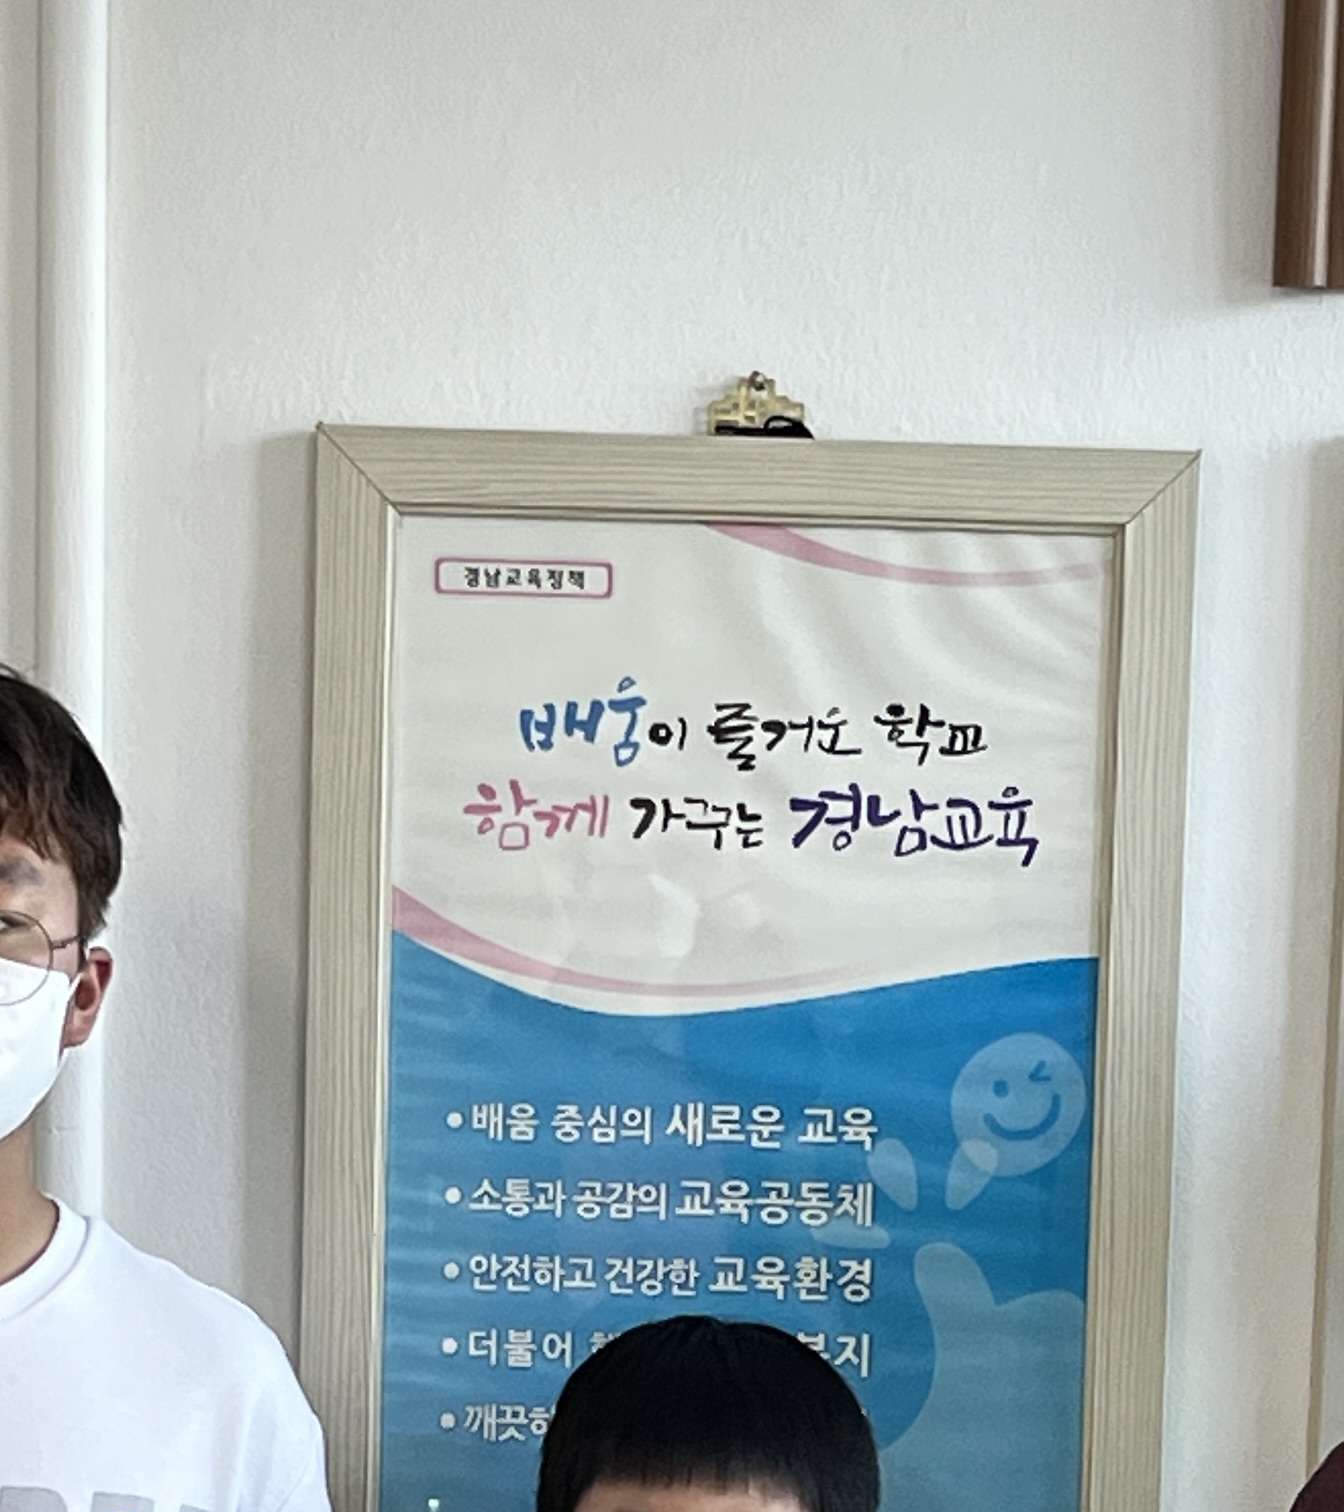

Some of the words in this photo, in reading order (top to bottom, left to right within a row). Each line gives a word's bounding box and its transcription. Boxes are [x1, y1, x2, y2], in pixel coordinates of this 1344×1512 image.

[463, 566, 585, 590] 경남교육정책
[519, 675, 688, 769] 배움이
[706, 701, 864, 772] 즐거운
[872, 702, 990, 767] 학교
[463, 779, 609, 853] 함께
[628, 796, 765, 852] 가꾸는
[789, 782, 1041, 868] 경남교육
[471, 1102, 539, 1141] 배움
[550, 1102, 654, 1145] 중심의
[664, 1101, 786, 1150] 새로운
[797, 1105, 879, 1151] 교육
[467, 1177, 566, 1218] 소통과
[573, 1179, 668, 1221] 공감의
[674, 1178, 874, 1228] 교육공동체
[468, 1253, 598, 1293] 안전하고
[603, 1255, 700, 1297] 건강한
[708, 1255, 874, 1303] 교육환경
[468, 1328, 573, 1369] 더불어
